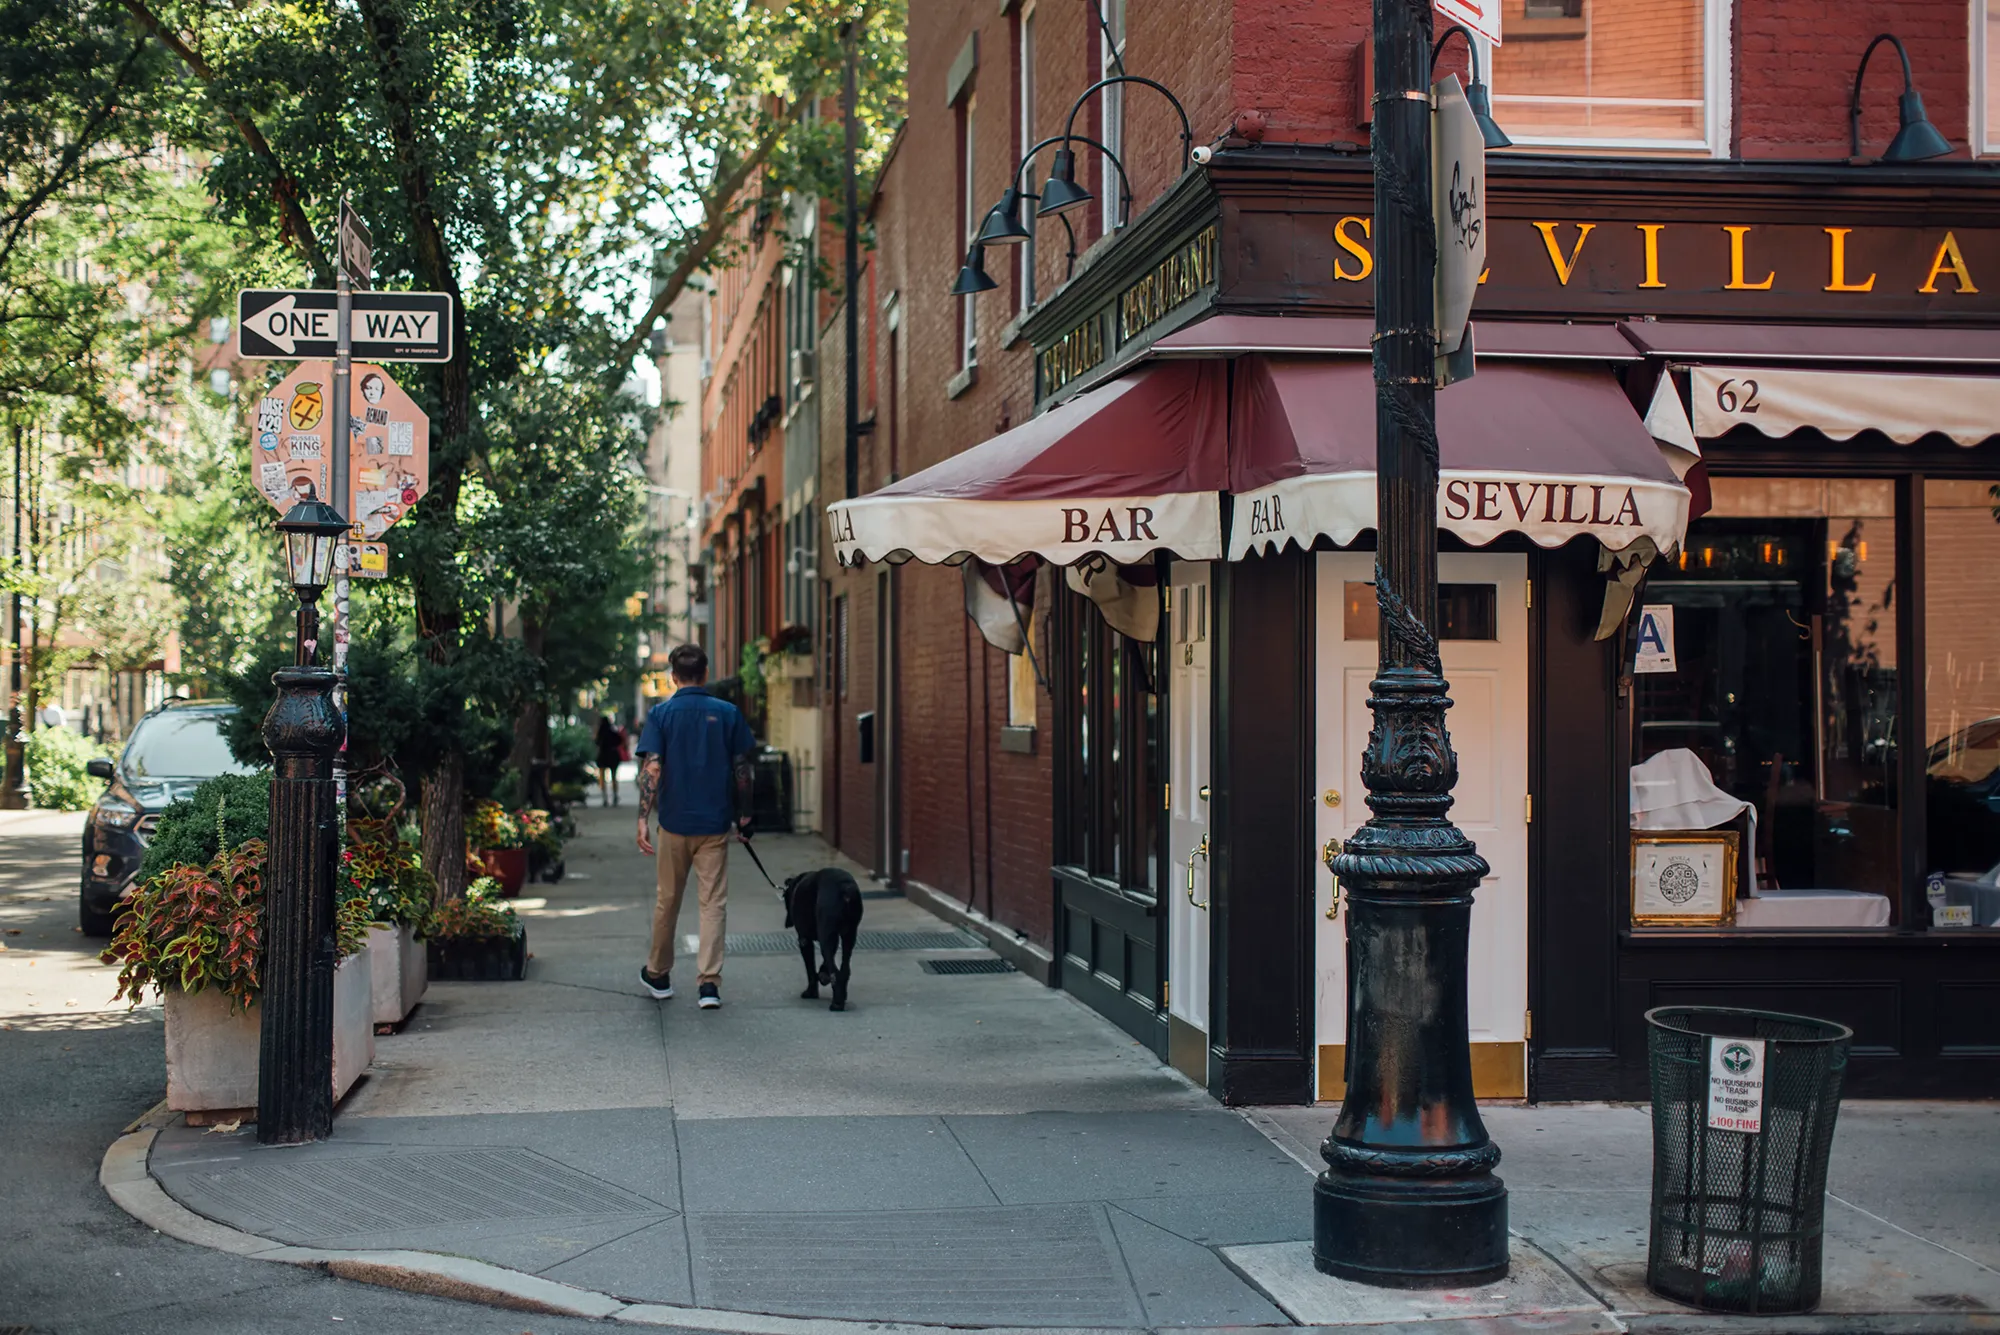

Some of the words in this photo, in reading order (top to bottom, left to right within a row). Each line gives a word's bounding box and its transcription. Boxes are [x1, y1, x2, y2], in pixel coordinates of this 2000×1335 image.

[1333, 216, 1979, 294] SVILLA
[1044, 313, 1105, 397] SEVILLA
[1122, 225, 1217, 343] RESTAURANT
[268, 312, 329, 337] ONE
[365, 314, 431, 339] WAY
[1716, 378, 1760, 414] 62
[258, 414, 283, 434] 429
[291, 441, 320, 451] KING
[1251, 493, 1286, 536] BAR
[1444, 480, 1643, 527] SEVILLA
[1060, 507, 1158, 544] BAR
[1636, 613, 1666, 653] A
[1711, 1077, 1721, 1085] NO
[1722, 1078, 1762, 1089] HOUSEHOLD
[1725, 1086, 1748, 1095] TRASH
[1714, 1095, 1724, 1104] NO
[1725, 1097, 1759, 1107] BUSINESS
[1725, 1105, 1748, 1113] TRASH
[1735, 1119, 1760, 1130] FINE
